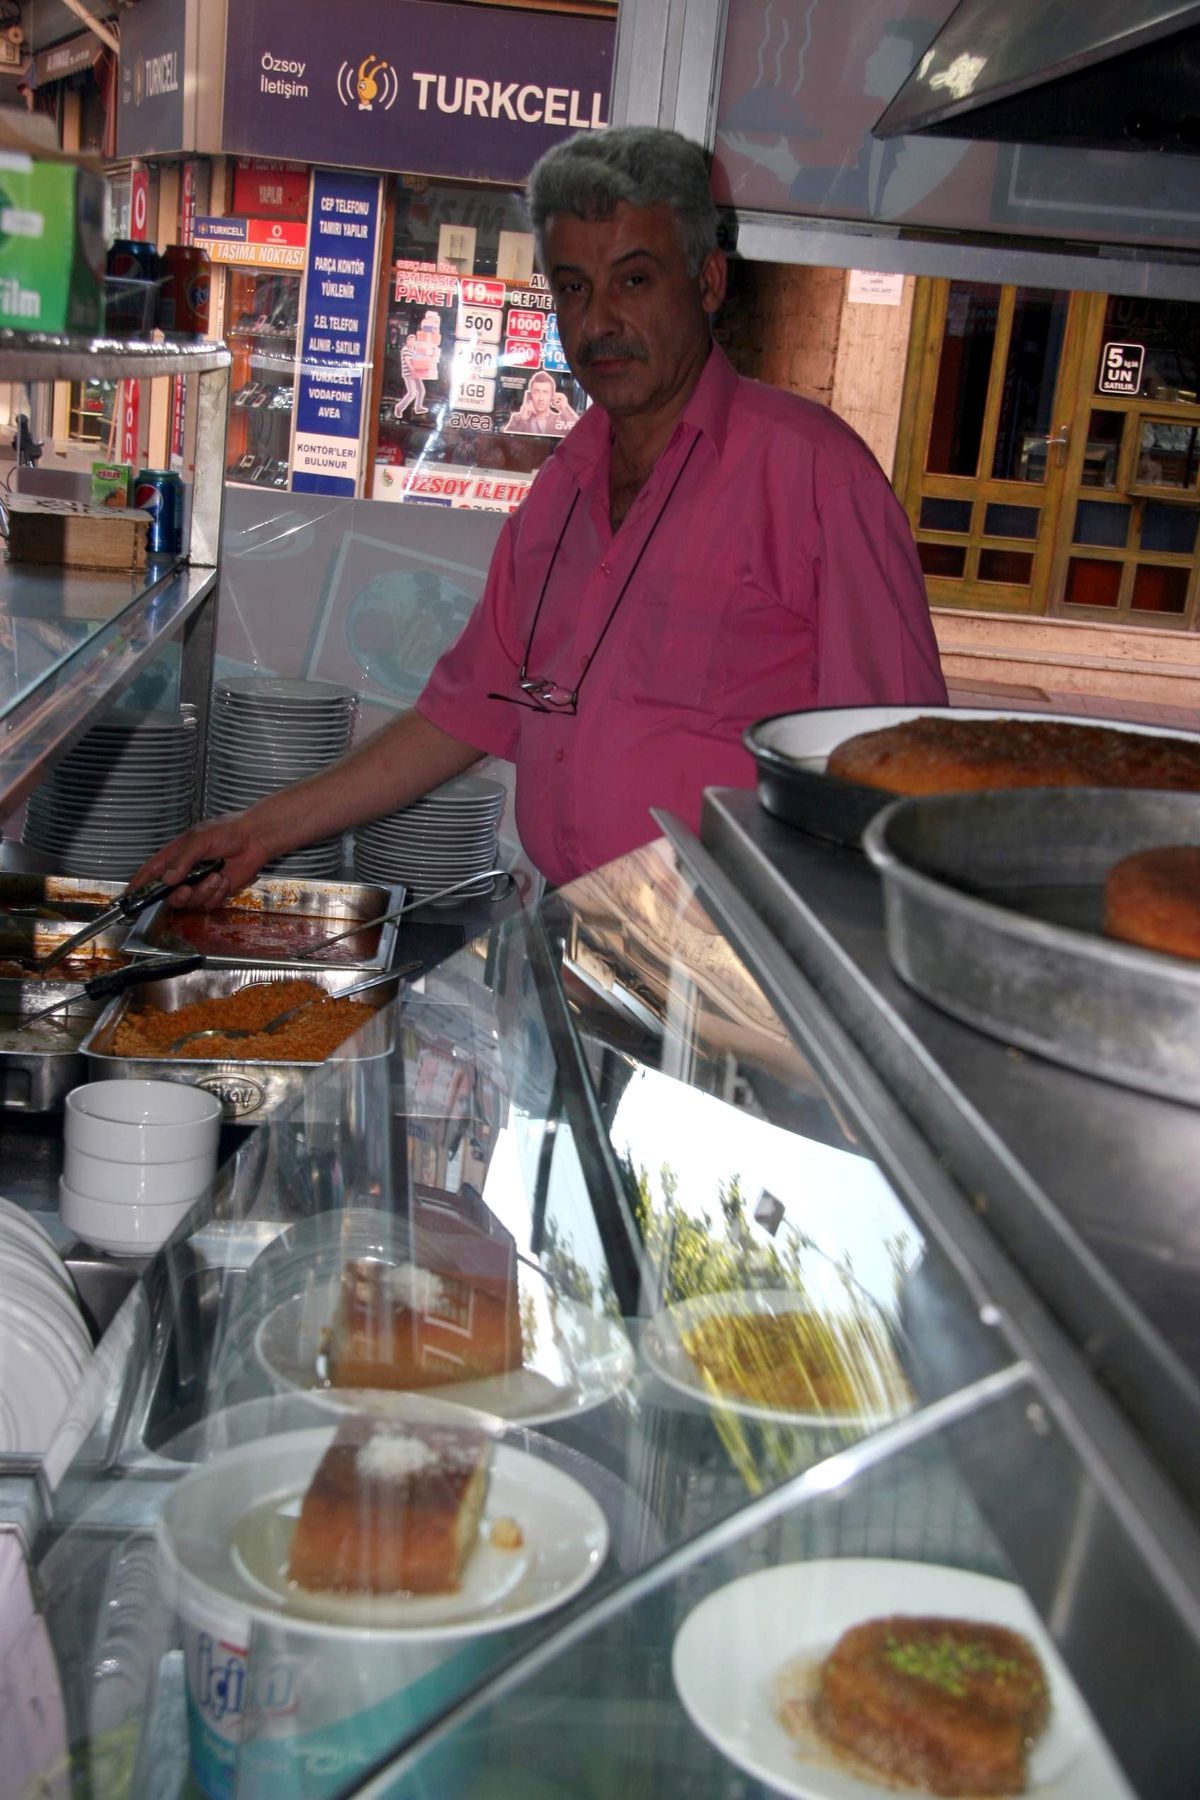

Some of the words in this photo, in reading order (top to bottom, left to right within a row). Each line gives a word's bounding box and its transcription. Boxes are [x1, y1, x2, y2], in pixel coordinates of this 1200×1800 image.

[261, 52, 306, 78] Özsoy
[260, 76, 309, 100] İletişim
[412, 72, 609, 130] TURKCELL
[321, 197, 335, 212] CEP
[335, 199, 370, 215] TELEFONU
[209, 224, 245, 237] TURKCELL
[343, 224, 368, 239] YAPILIR
[217, 244, 255, 261] TAŞIMA
[258, 247, 305, 266] NOKTASI
[315, 257, 336, 276] PARÇA
[337, 258, 365, 275] KONTÖR
[321, 280, 355, 299] YÜKLENİR
[395, 283, 458, 308] PAKET
[511, 292, 552, 309] CEPTE
[313, 315, 328, 330] 2.EL
[329, 316, 358, 333] TELEFON
[465, 315, 493, 332] 500
[510, 317, 541, 332] 1000
[309, 338, 331, 353] ALINIR
[335, 339, 361, 356] SATILIR
[1107, 348, 1123, 368] 5
[310, 370, 354, 386] TURKCELL
[1107, 369, 1133, 382] UN
[308, 388, 353, 403] VODAFONE
[459, 383, 485, 398] 1GB
[318, 406, 340, 419] AVEA
[450, 413, 491, 431] avea
[305, 456, 348, 469] BULUNUR
